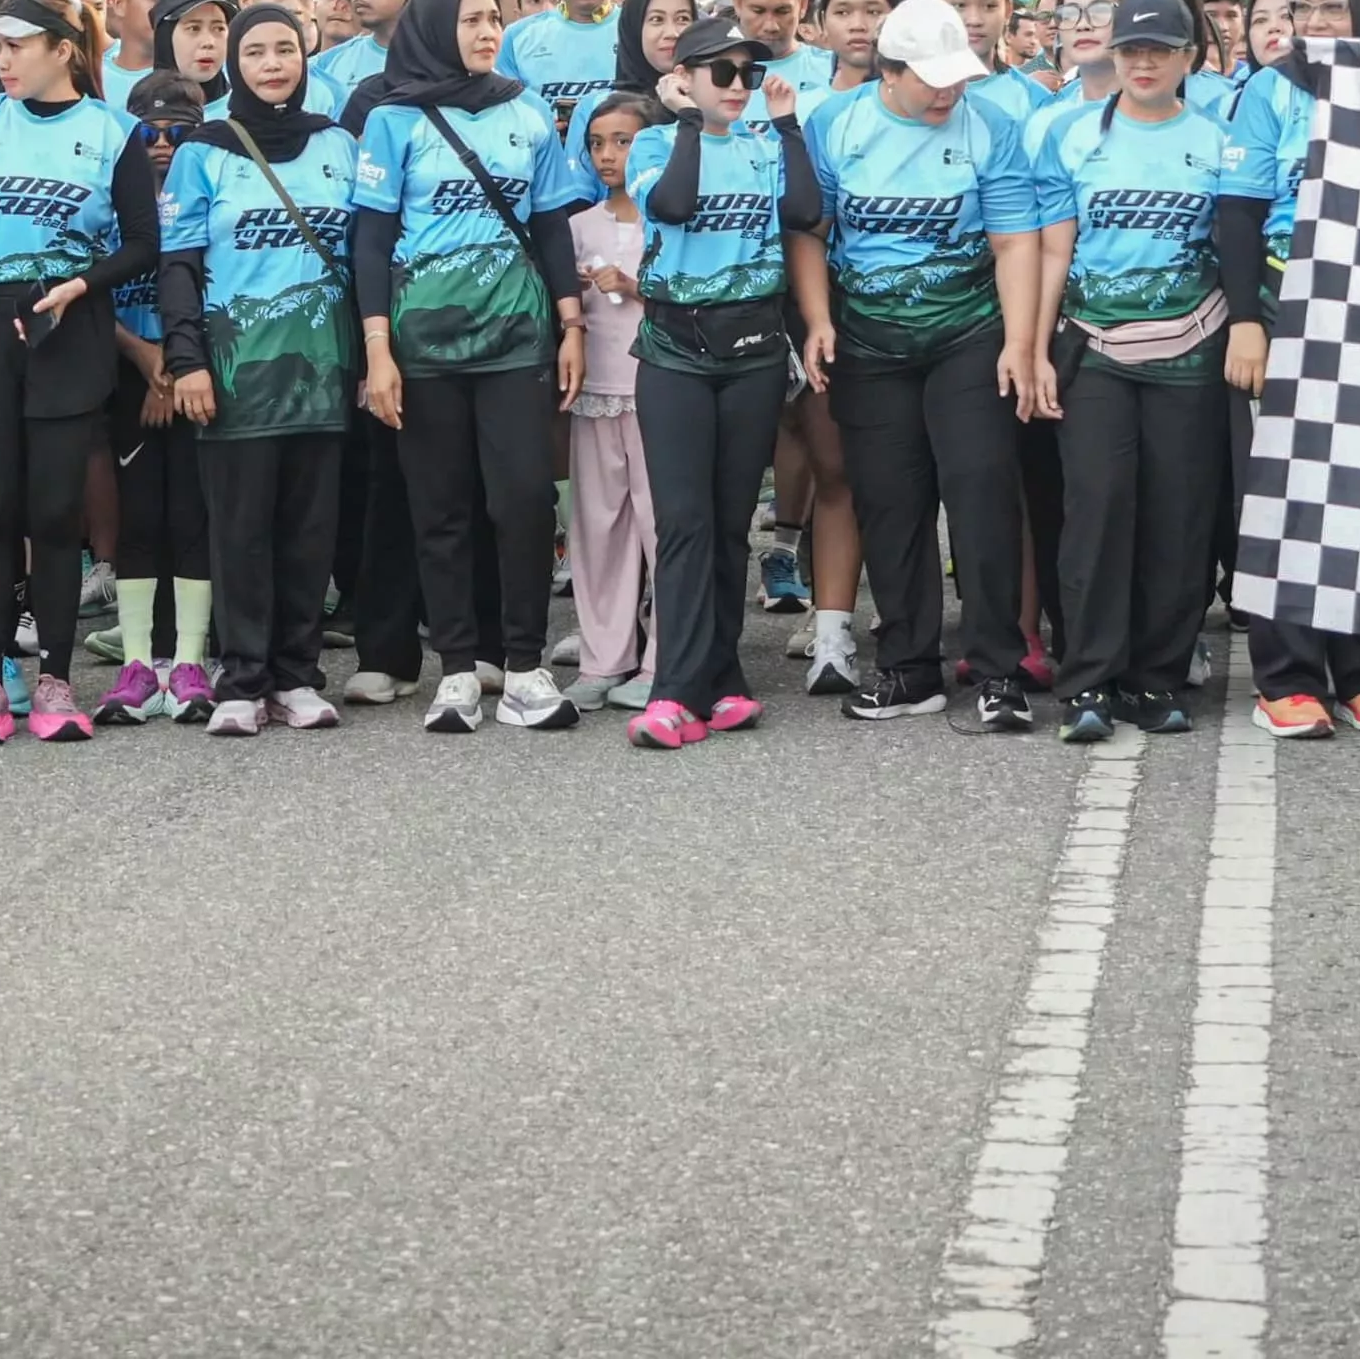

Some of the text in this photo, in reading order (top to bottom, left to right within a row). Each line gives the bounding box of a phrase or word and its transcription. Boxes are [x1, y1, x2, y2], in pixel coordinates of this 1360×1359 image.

[843, 195, 964, 216] ROAD
[1088, 189, 1208, 212] ROAD
[857, 217, 959, 236] RBR
[1088, 209, 1200, 230] TO RBR
[234, 228, 257, 239] TO
